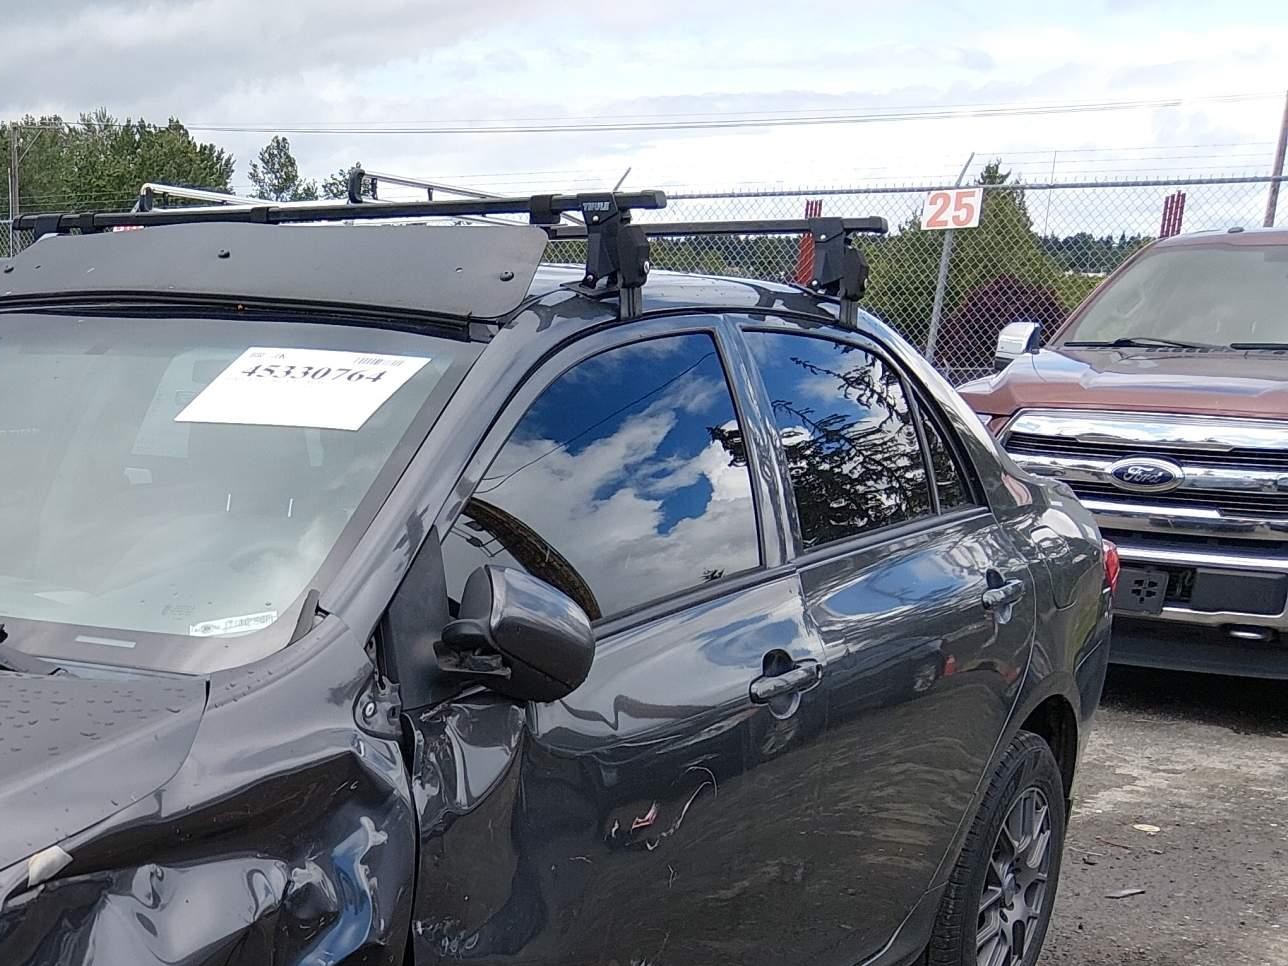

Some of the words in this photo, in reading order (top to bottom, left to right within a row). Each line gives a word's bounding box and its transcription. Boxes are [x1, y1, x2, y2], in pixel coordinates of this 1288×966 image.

[926, 190, 977, 228] 25
[242, 364, 387, 383] 45330764
[1123, 465, 1164, 483] Ford
